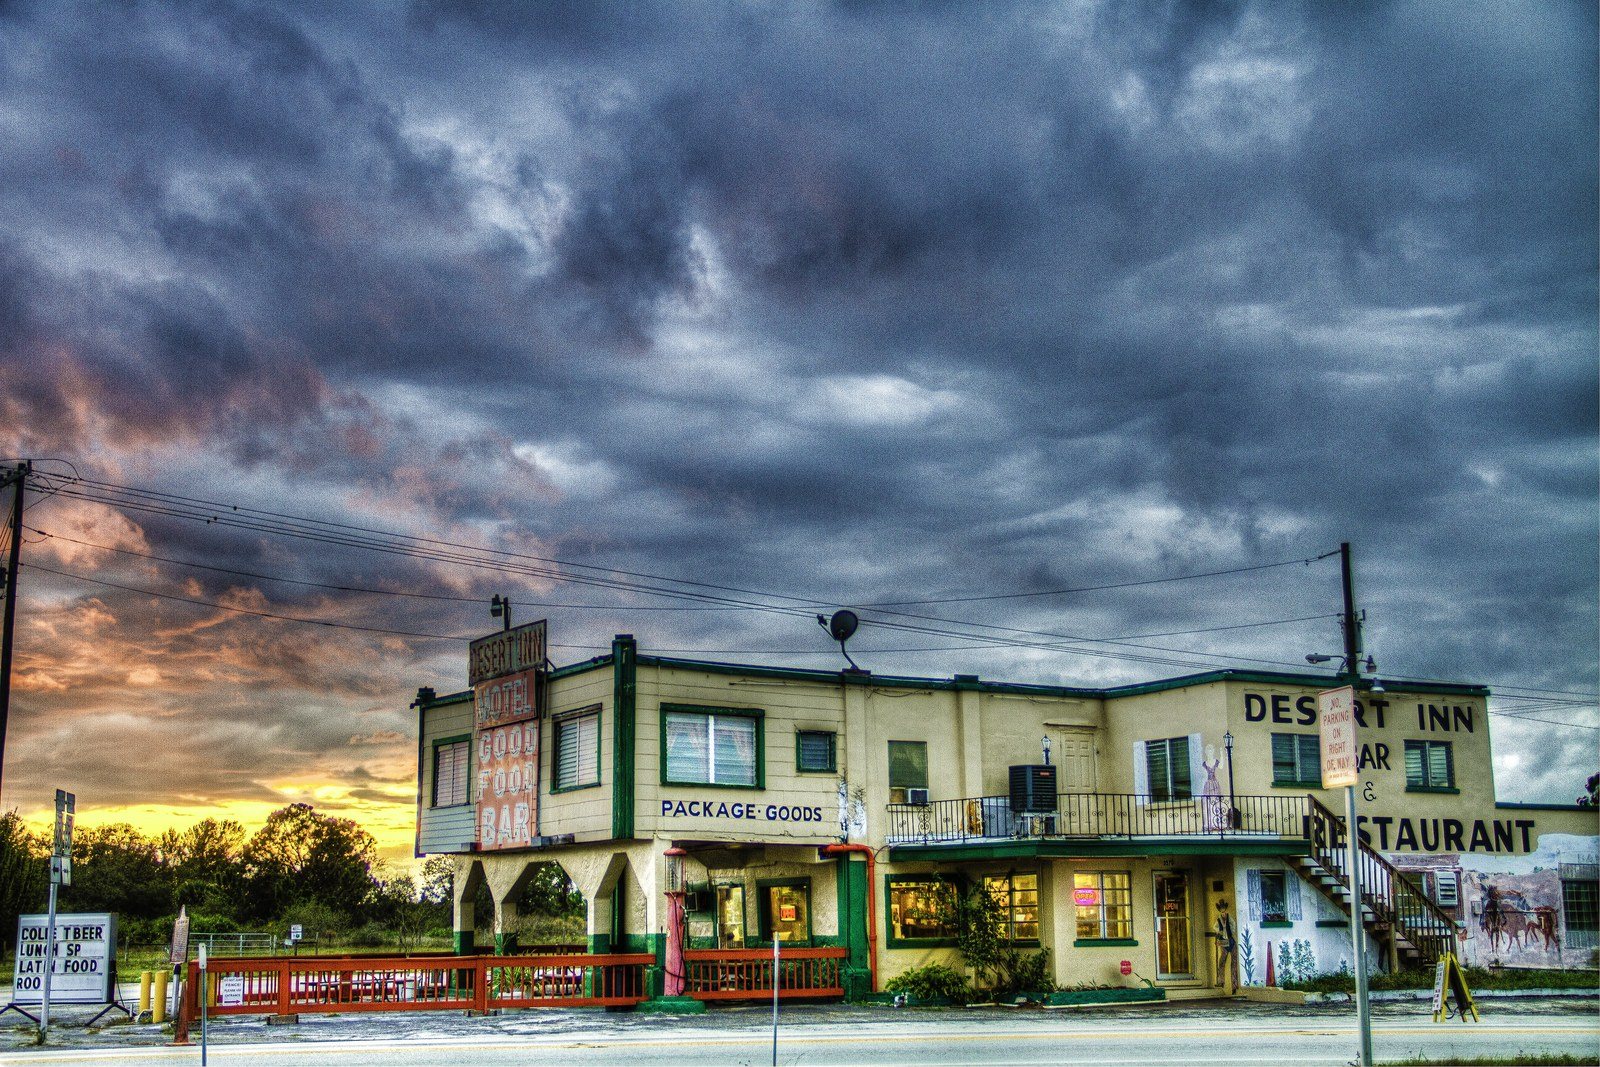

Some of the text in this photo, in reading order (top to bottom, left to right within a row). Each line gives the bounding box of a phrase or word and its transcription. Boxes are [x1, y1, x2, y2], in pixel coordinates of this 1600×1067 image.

[518, 627, 543, 666] INN
[477, 677, 531, 721] MOTEL
[1244, 693, 1474, 733] DESRT INN
[1323, 710, 1349, 726] PARKING
[1332, 728, 1341, 739] ON
[478, 721, 537, 764] GOOD
[1328, 741, 1346, 755] RIGHT
[1337, 757, 1350, 770] WAY
[1355, 742, 1391, 773] AR
[478, 761, 534, 800] FOOD
[766, 805, 822, 822] GOODS
[481, 802, 530, 846] BAR
[74, 927, 102, 940] BEER
[67, 944, 81, 957] SP
[64, 960, 97, 973] FOOD
